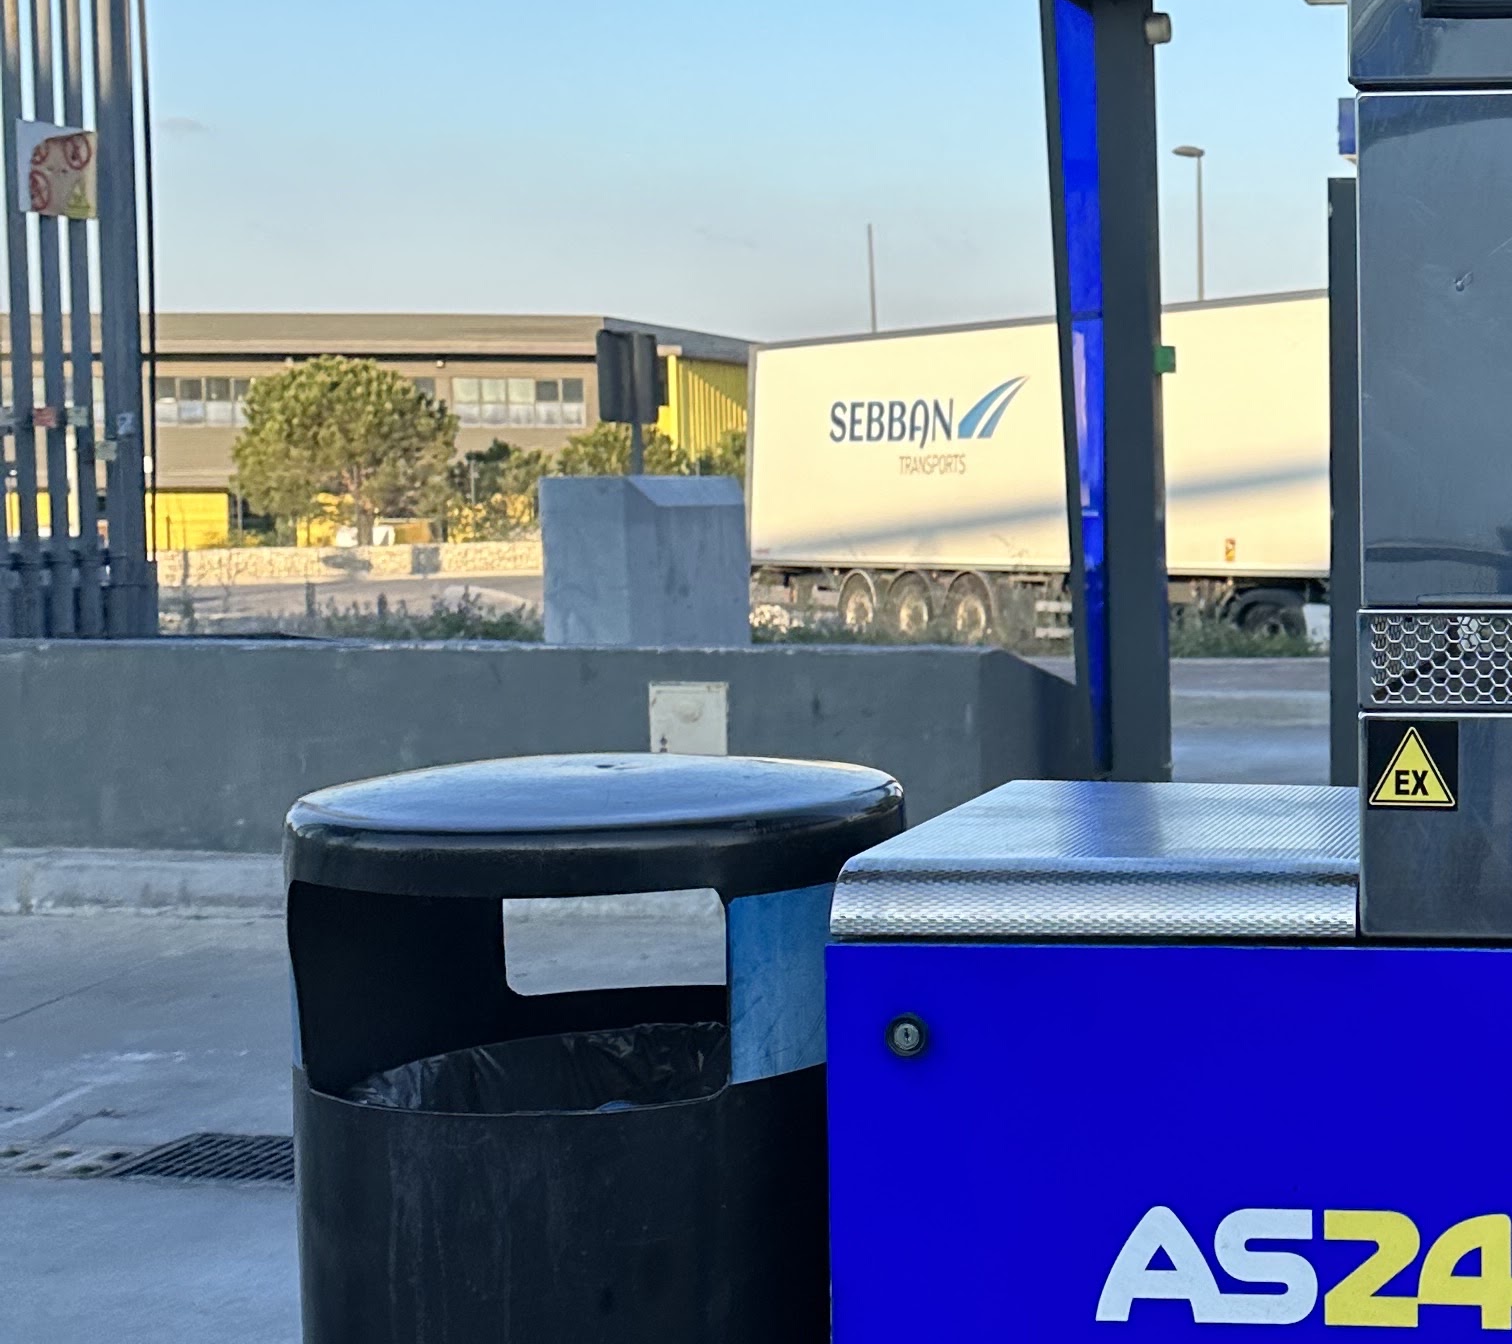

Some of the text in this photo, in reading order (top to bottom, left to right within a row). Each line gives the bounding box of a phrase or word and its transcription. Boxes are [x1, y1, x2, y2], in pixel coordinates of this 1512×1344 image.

[829, 397, 954, 449] SEBBAN
[899, 453, 966, 476] TRANSPORTS
[1394, 770, 1429, 796] EX
